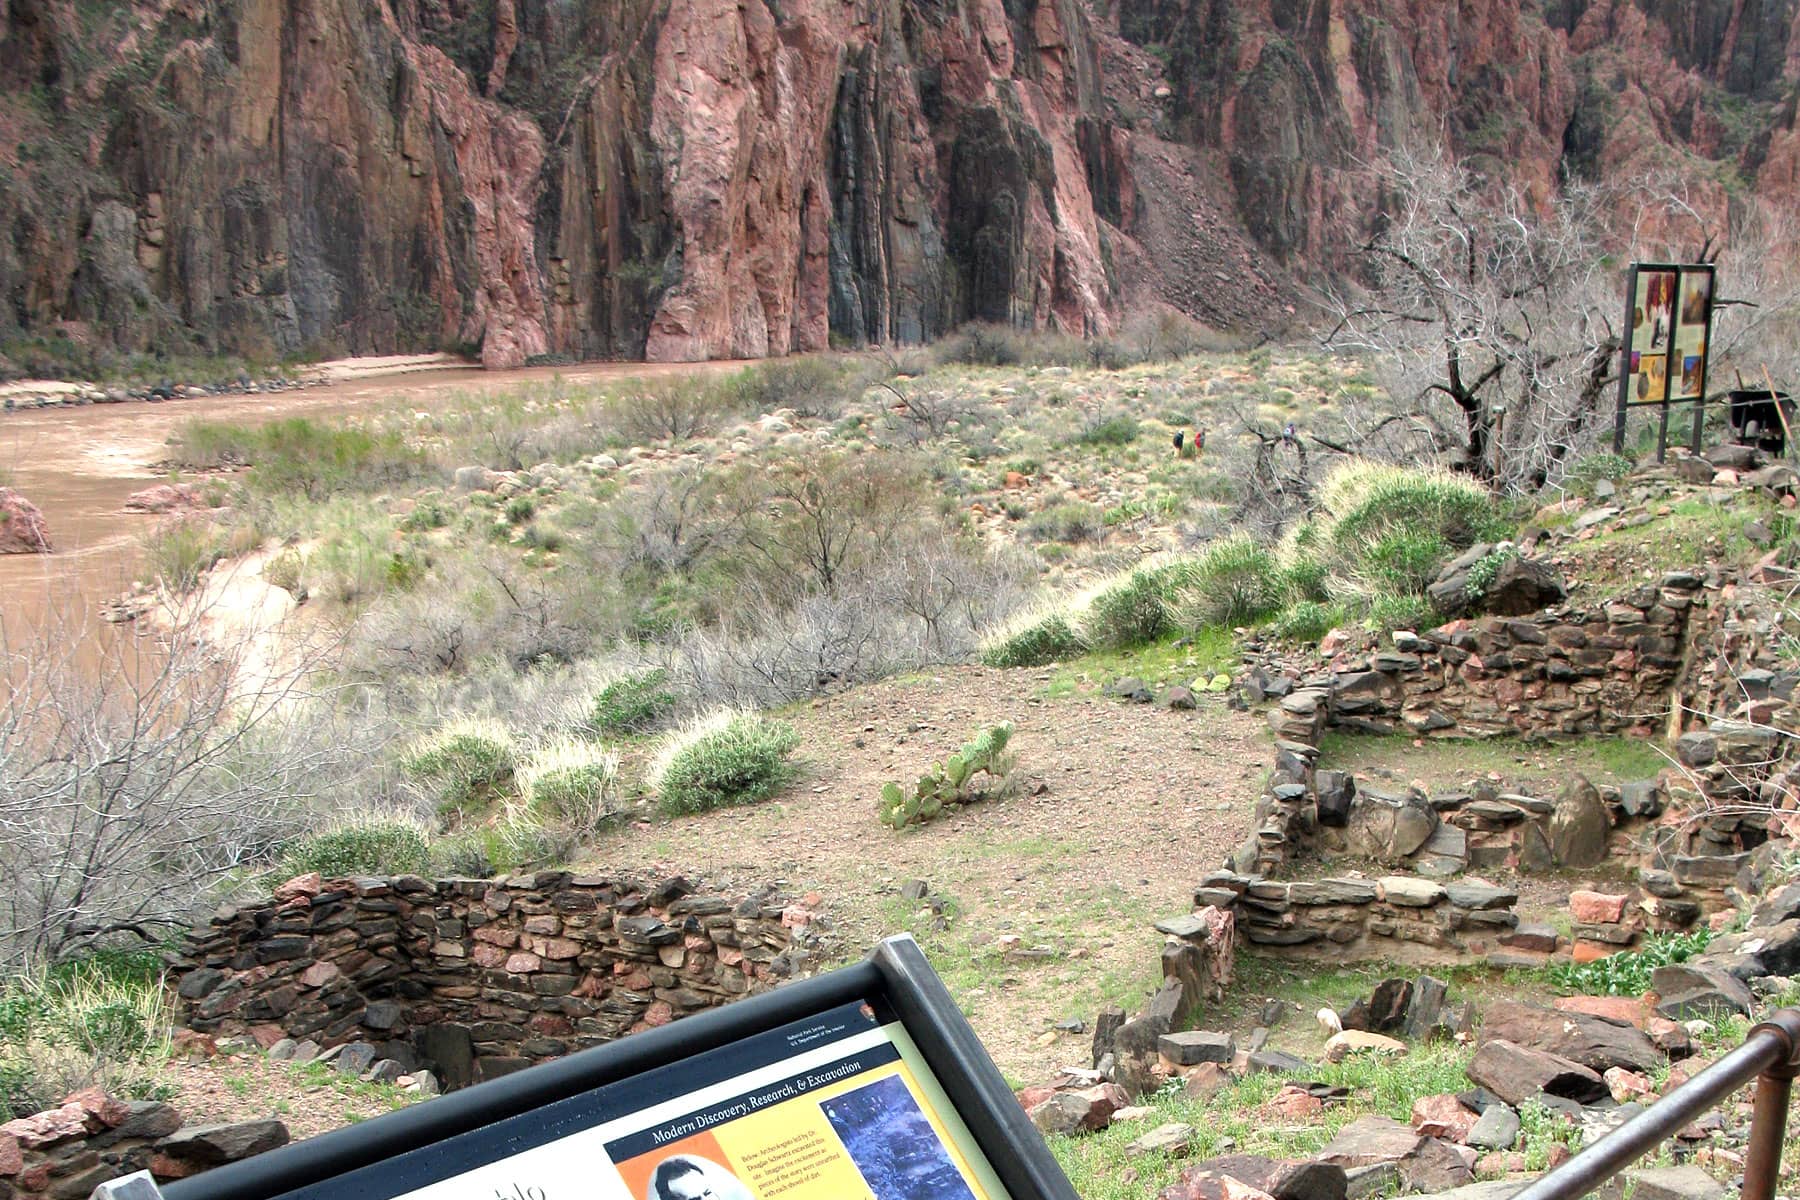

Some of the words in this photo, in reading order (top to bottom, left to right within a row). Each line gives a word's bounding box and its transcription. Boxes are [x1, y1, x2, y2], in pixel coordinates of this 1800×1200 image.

[652, 1122, 695, 1143] Modern
[695, 1103, 750, 1127] Discovery,
[749, 1084, 797, 1107] Research,
[796, 1079, 806, 1090] &
[806, 1062, 860, 1086] Excavation
